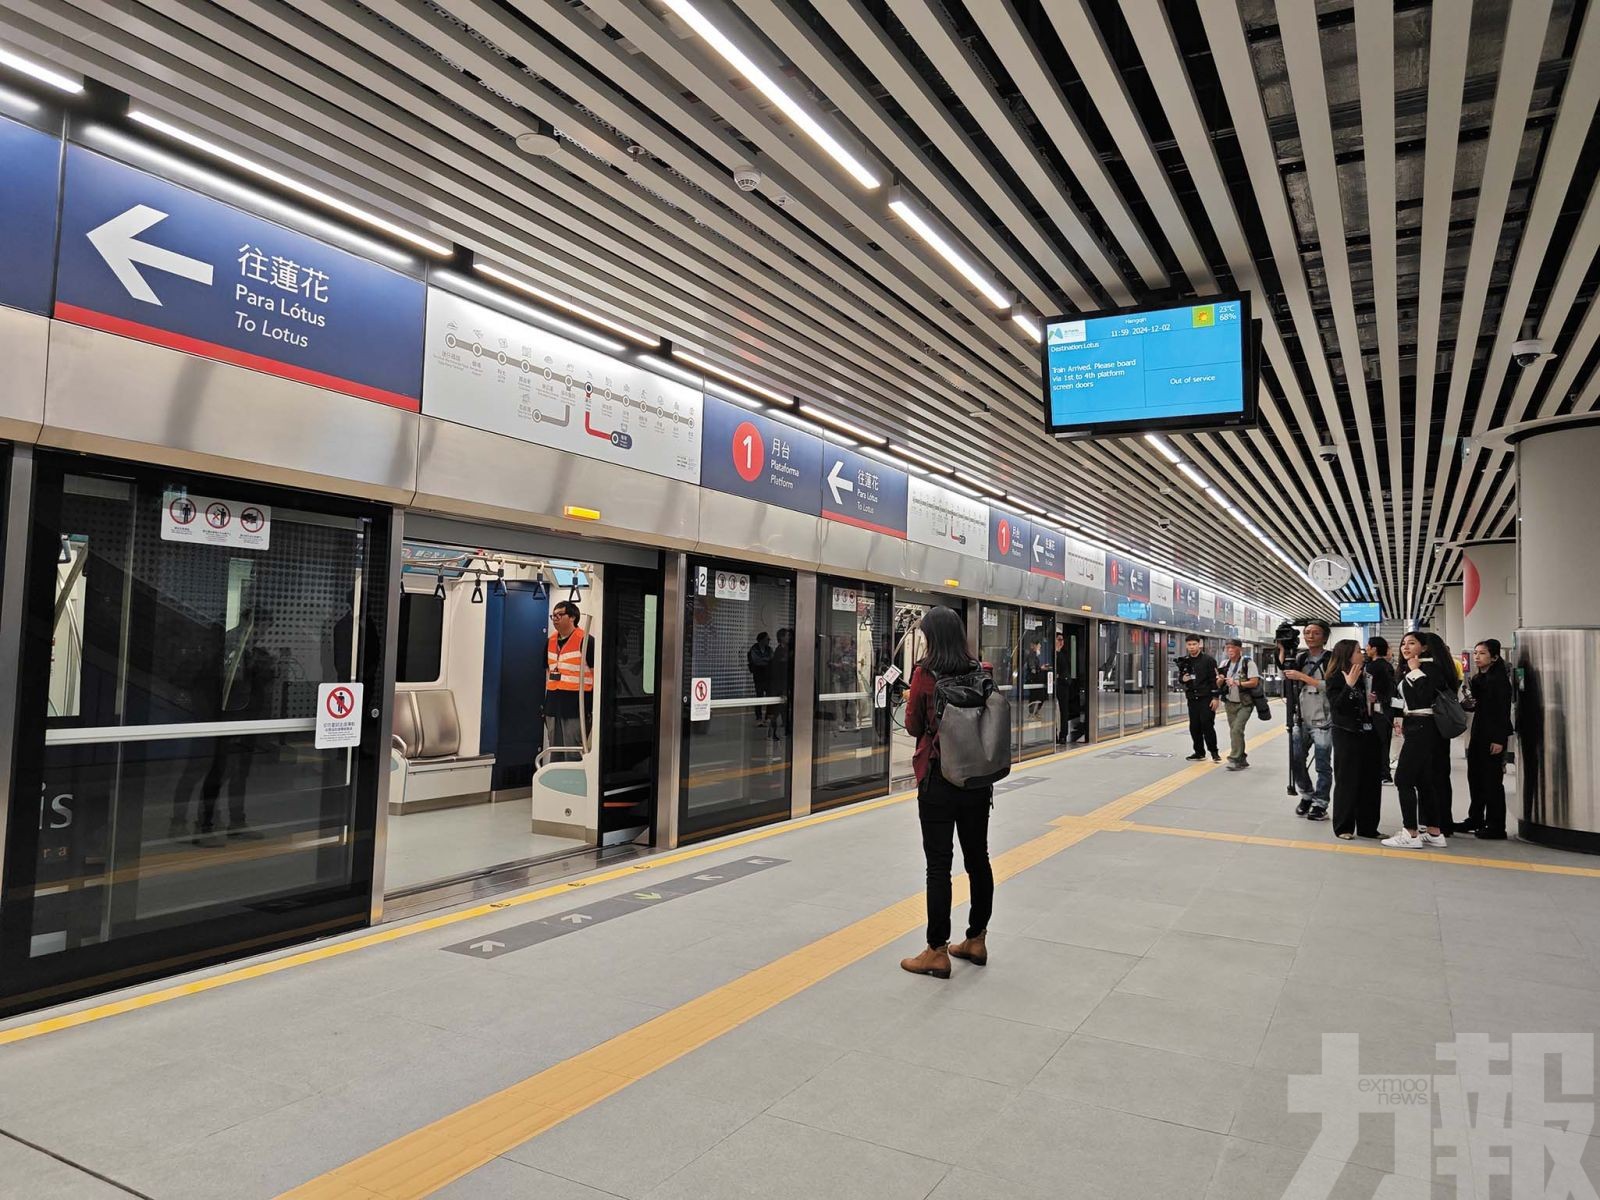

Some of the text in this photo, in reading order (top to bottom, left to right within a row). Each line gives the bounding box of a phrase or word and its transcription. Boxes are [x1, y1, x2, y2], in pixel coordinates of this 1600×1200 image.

[237, 244, 330, 303] 往蓮花
[235, 283, 326, 327] Para Lótus
[235, 311, 309, 347] To Lotus
[1111, 323, 1171, 337] 11:59 2024-12-02
[1052, 366, 1066, 374] Train
[1094, 361, 1115, 370] Please
[1116, 359, 1137, 368] board
[1097, 369, 1125, 379] platform
[1052, 381, 1094, 391] screen doors
[1192, 375, 1216, 383] service
[742, 435, 753, 469] 1
[771, 438, 790, 460] 月台
[770, 459, 800, 477] Plataforma
[770, 474, 794, 489] Platform
[700, 573, 706, 587] 2
